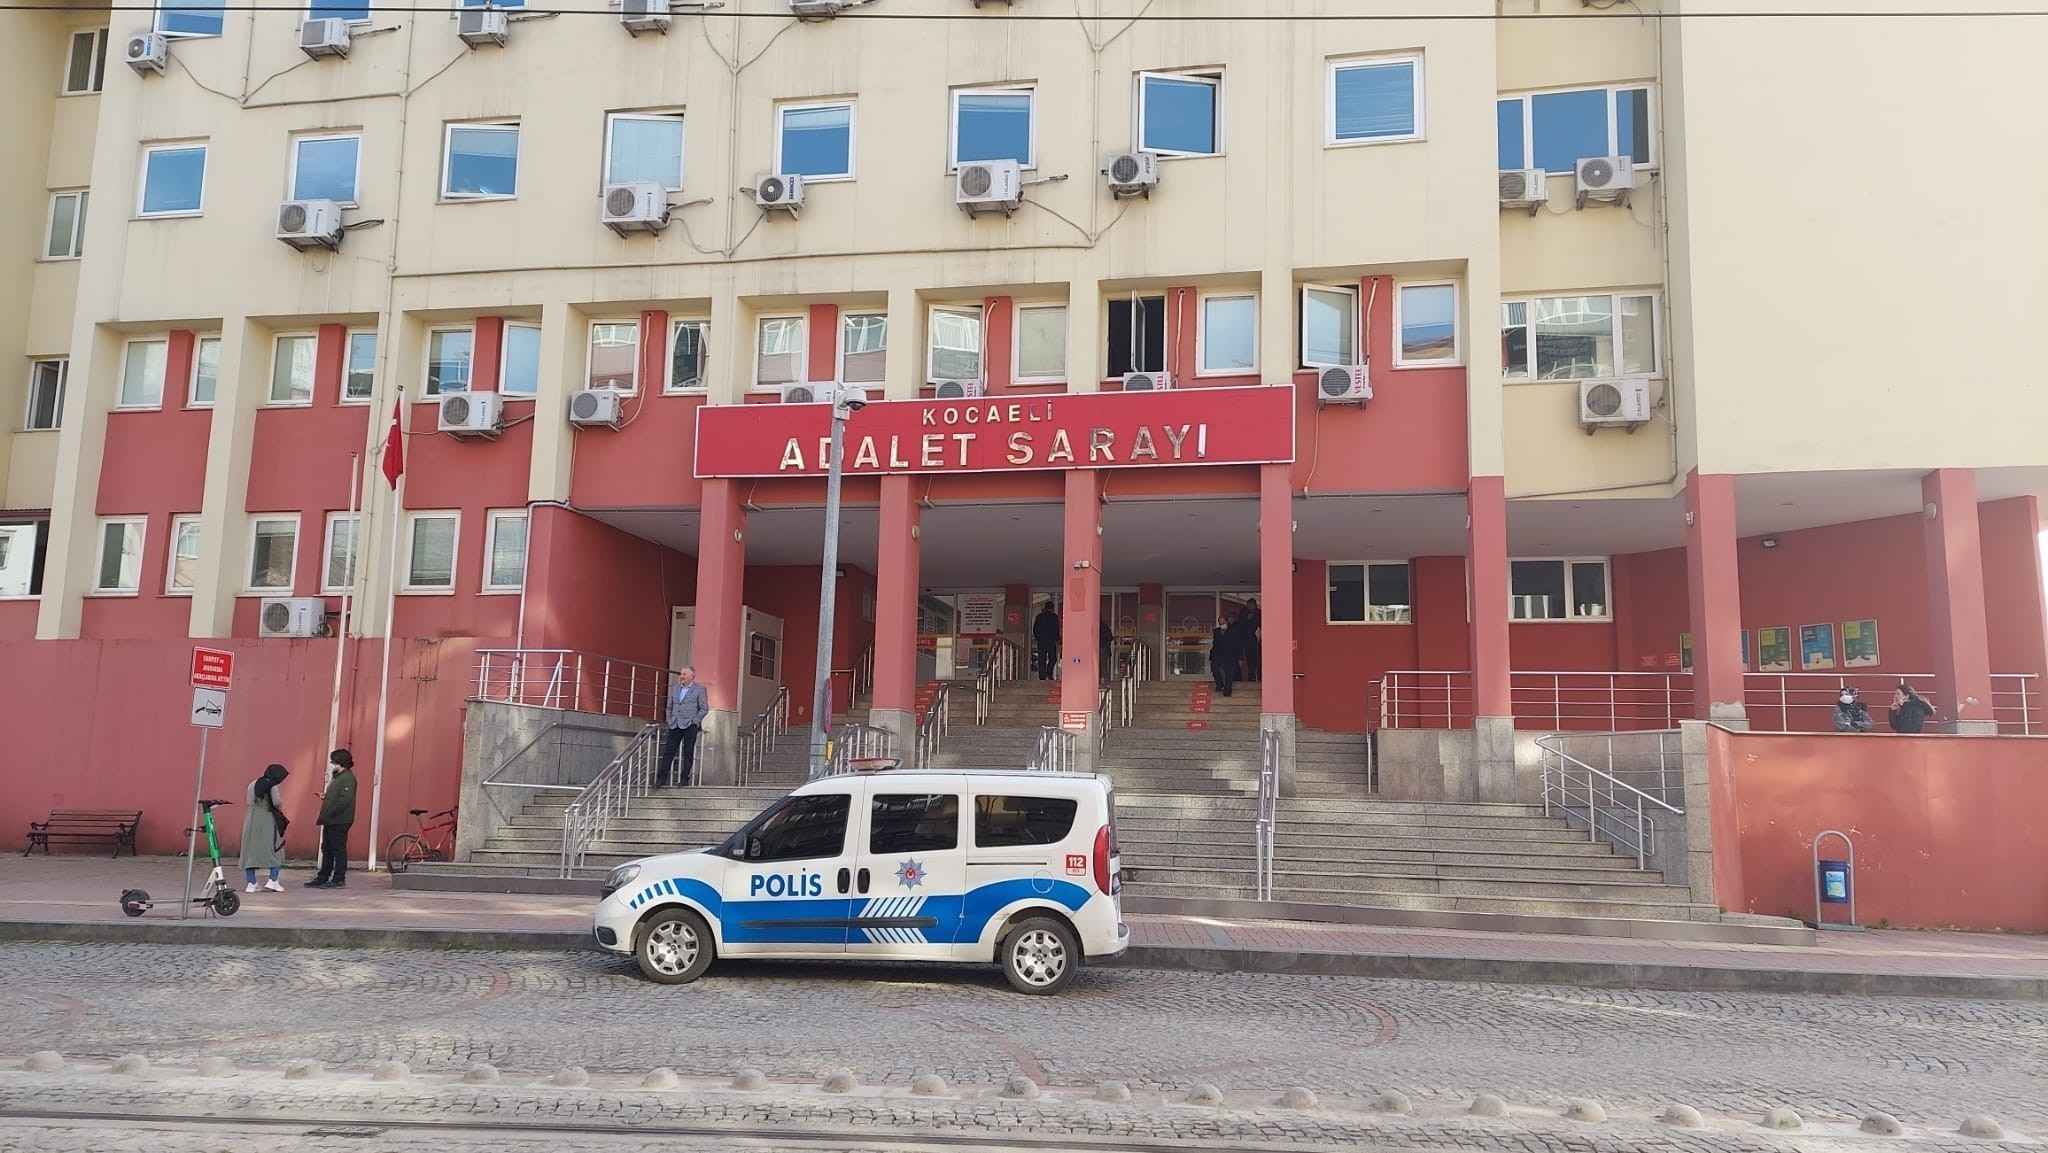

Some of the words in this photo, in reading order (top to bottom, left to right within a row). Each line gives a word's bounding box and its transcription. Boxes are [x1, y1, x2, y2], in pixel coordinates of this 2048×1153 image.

[1354, 368, 1362, 394] VESTEL
[922, 400, 1053, 426] KOCAELİ
[779, 433, 976, 471] ADALET
[1006, 423, 1207, 465] SARAYI
[1069, 856, 1084, 868] 112
[750, 867, 822, 897] POLİS
